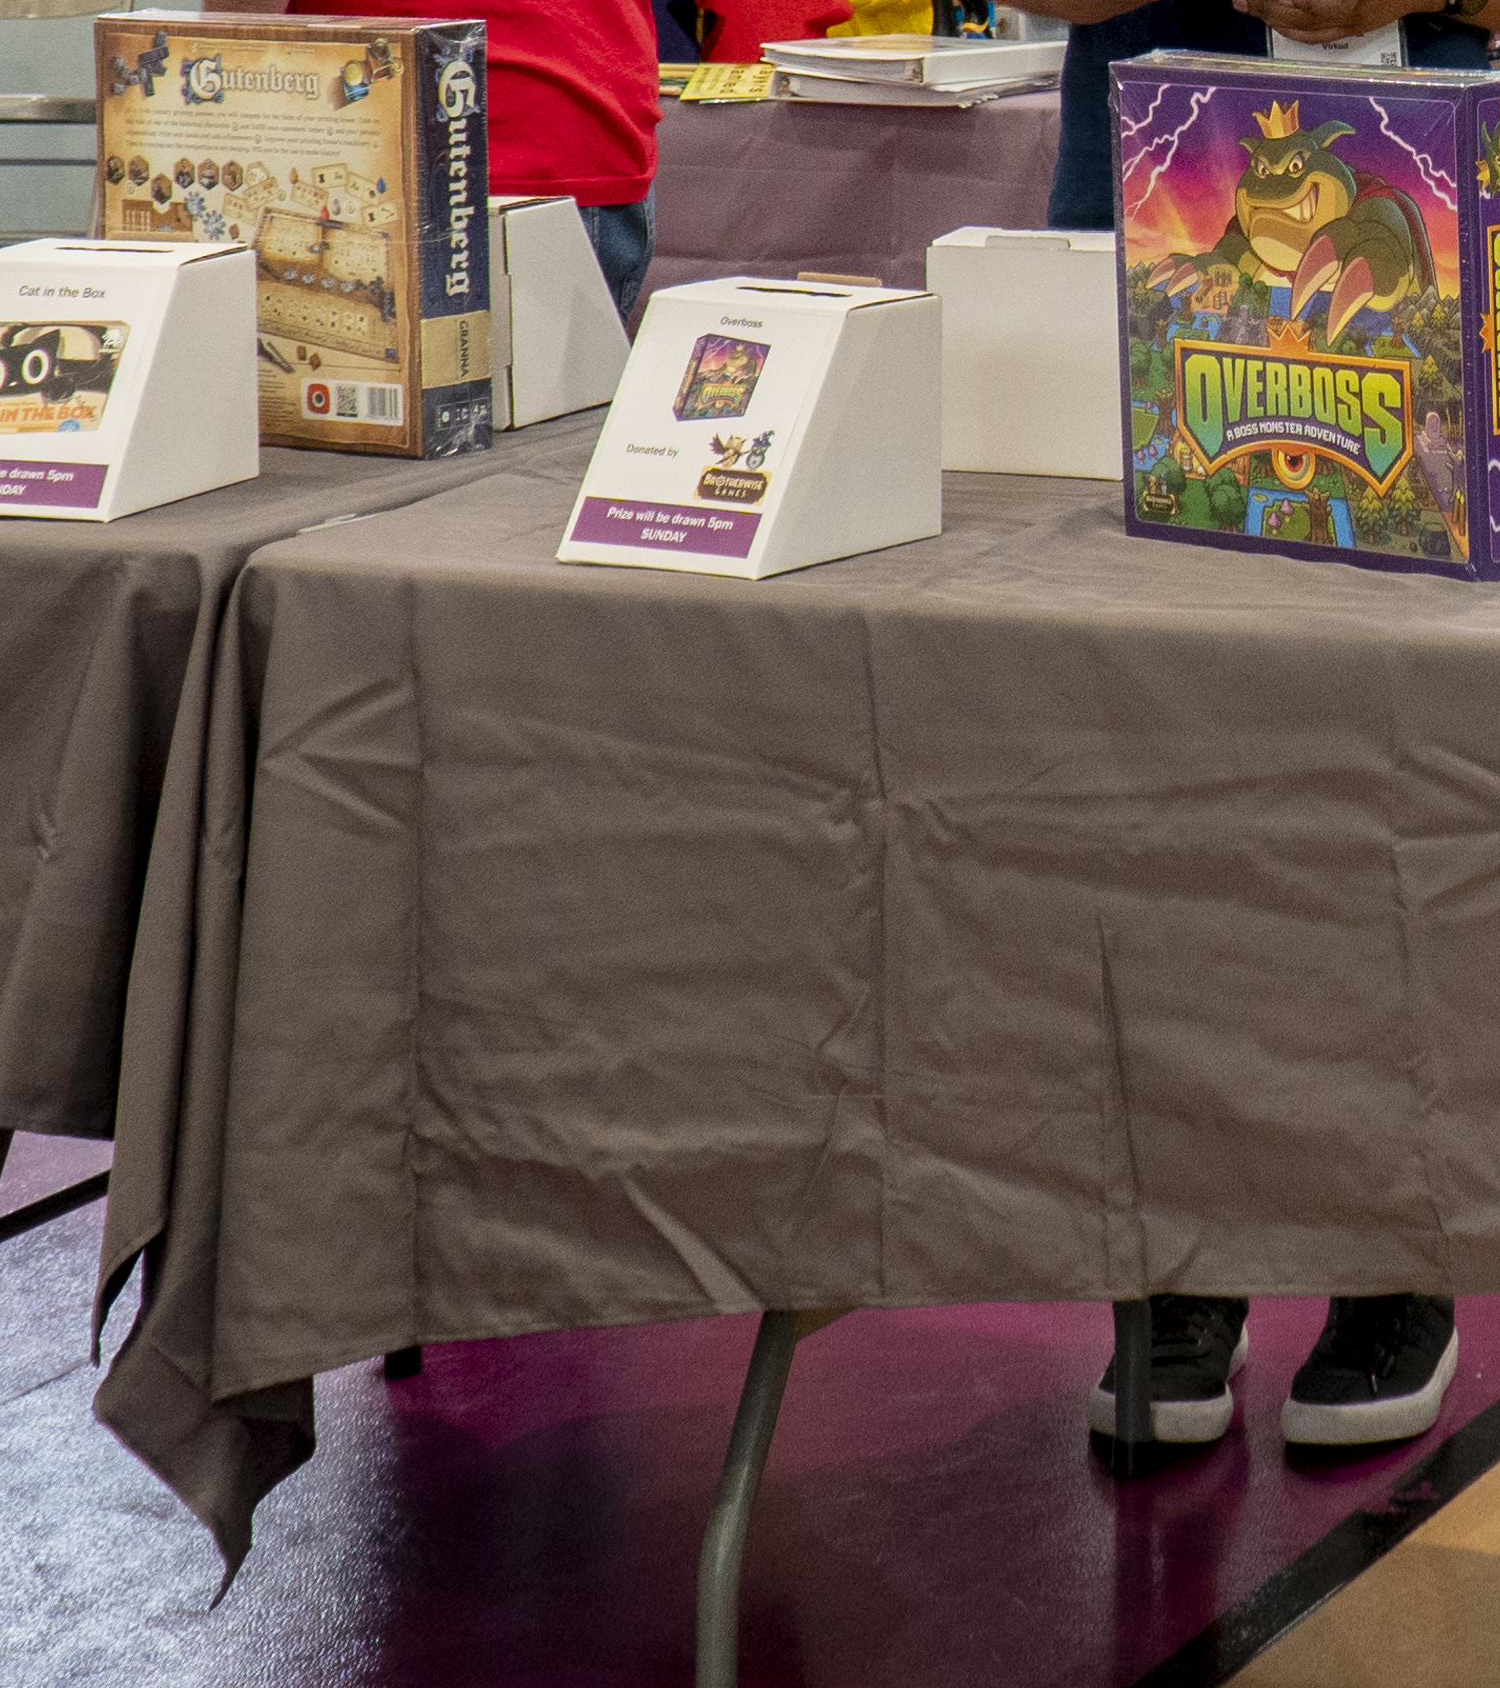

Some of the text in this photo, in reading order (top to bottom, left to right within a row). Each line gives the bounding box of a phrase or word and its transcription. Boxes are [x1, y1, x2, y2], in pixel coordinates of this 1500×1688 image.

[188, 58, 319, 100] Gutenberg
[438, 60, 476, 297] Gutenberg
[18, 285, 106, 299] Cat in the Box
[720, 316, 763, 329] Overboss
[459, 320, 469, 377] GRANNA
[0, 407, 16, 423] IN
[21, 406, 55, 421] THE
[57, 404, 97, 420] BOX
[1185, 354, 1404, 478] OVERBOSS
[1234, 423, 1258, 439] BOSS
[1260, 421, 1303, 434] MONSTER
[1304, 425, 1360, 455] ADVENTURE
[626, 444, 679, 459] Donated by
[9, 468, 45, 480] drawn
[47, 469, 74, 483] 5pm
[607, 506, 733, 531] Prize will be drawn 5pm
[640, 528, 687, 542] SUNDAY
